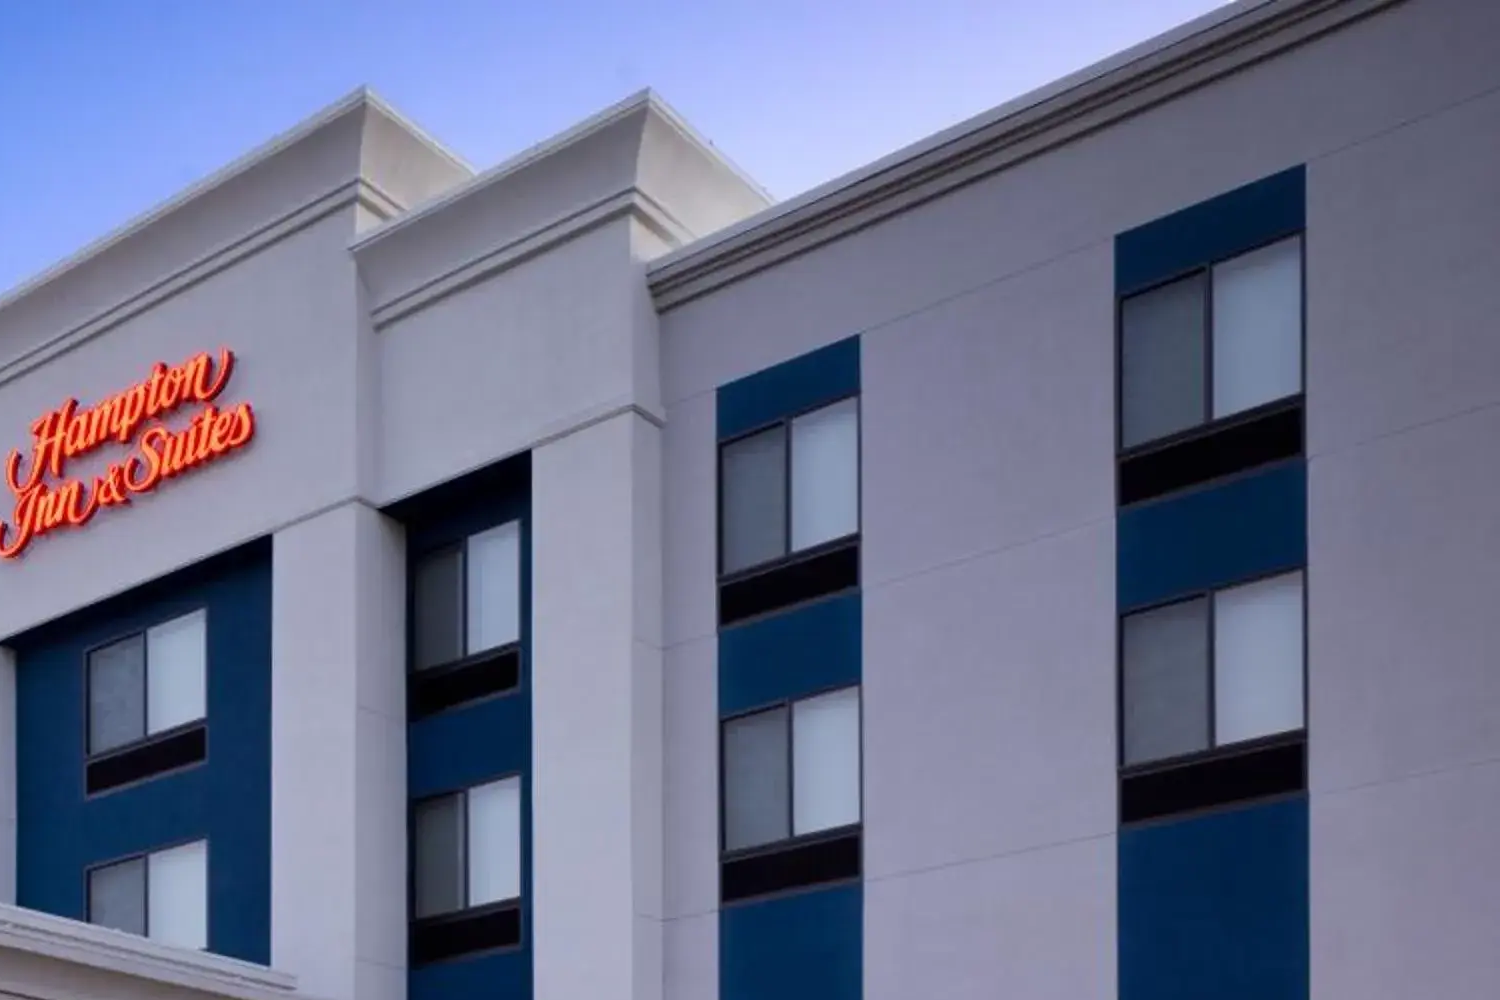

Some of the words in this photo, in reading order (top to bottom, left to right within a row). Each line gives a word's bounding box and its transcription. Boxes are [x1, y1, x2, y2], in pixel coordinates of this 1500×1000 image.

[6, 345, 234, 493] Hampton
[97, 464, 130, 505] &
[124, 403, 255, 492] Suites
